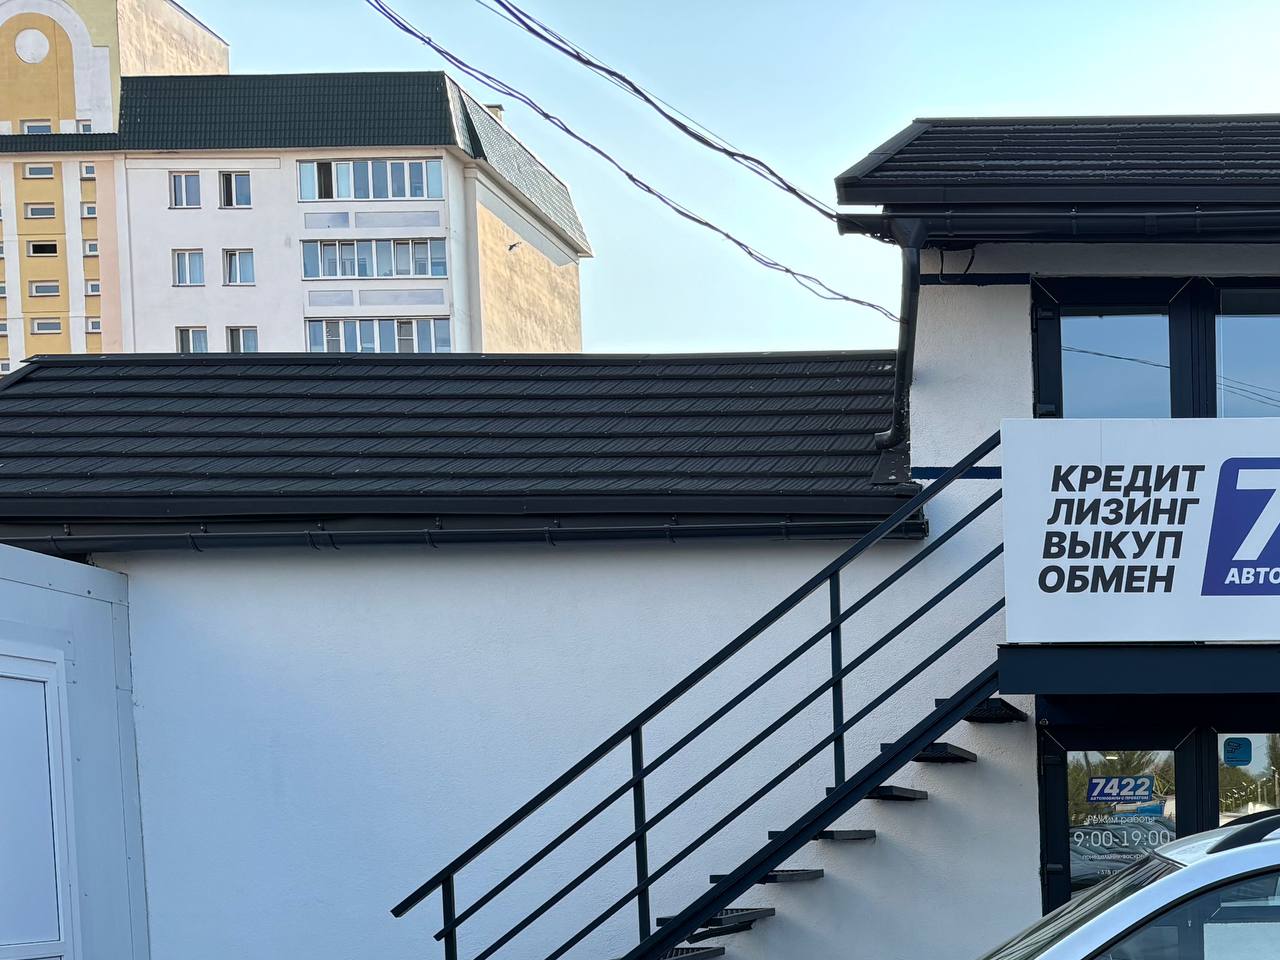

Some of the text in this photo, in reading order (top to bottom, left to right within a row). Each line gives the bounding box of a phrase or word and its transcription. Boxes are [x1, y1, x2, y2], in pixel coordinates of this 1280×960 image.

[1050, 465, 1205, 497] КРЕДИТ
[1047, 498, 1200, 525] ЛИЗИНГ
[1042, 530, 1184, 560] ВЫКУП
[1038, 564, 1175, 594] ОБМЕН
[1091, 778, 1150, 796] 7422
[1073, 830, 1170, 847] 9:00-19:00
